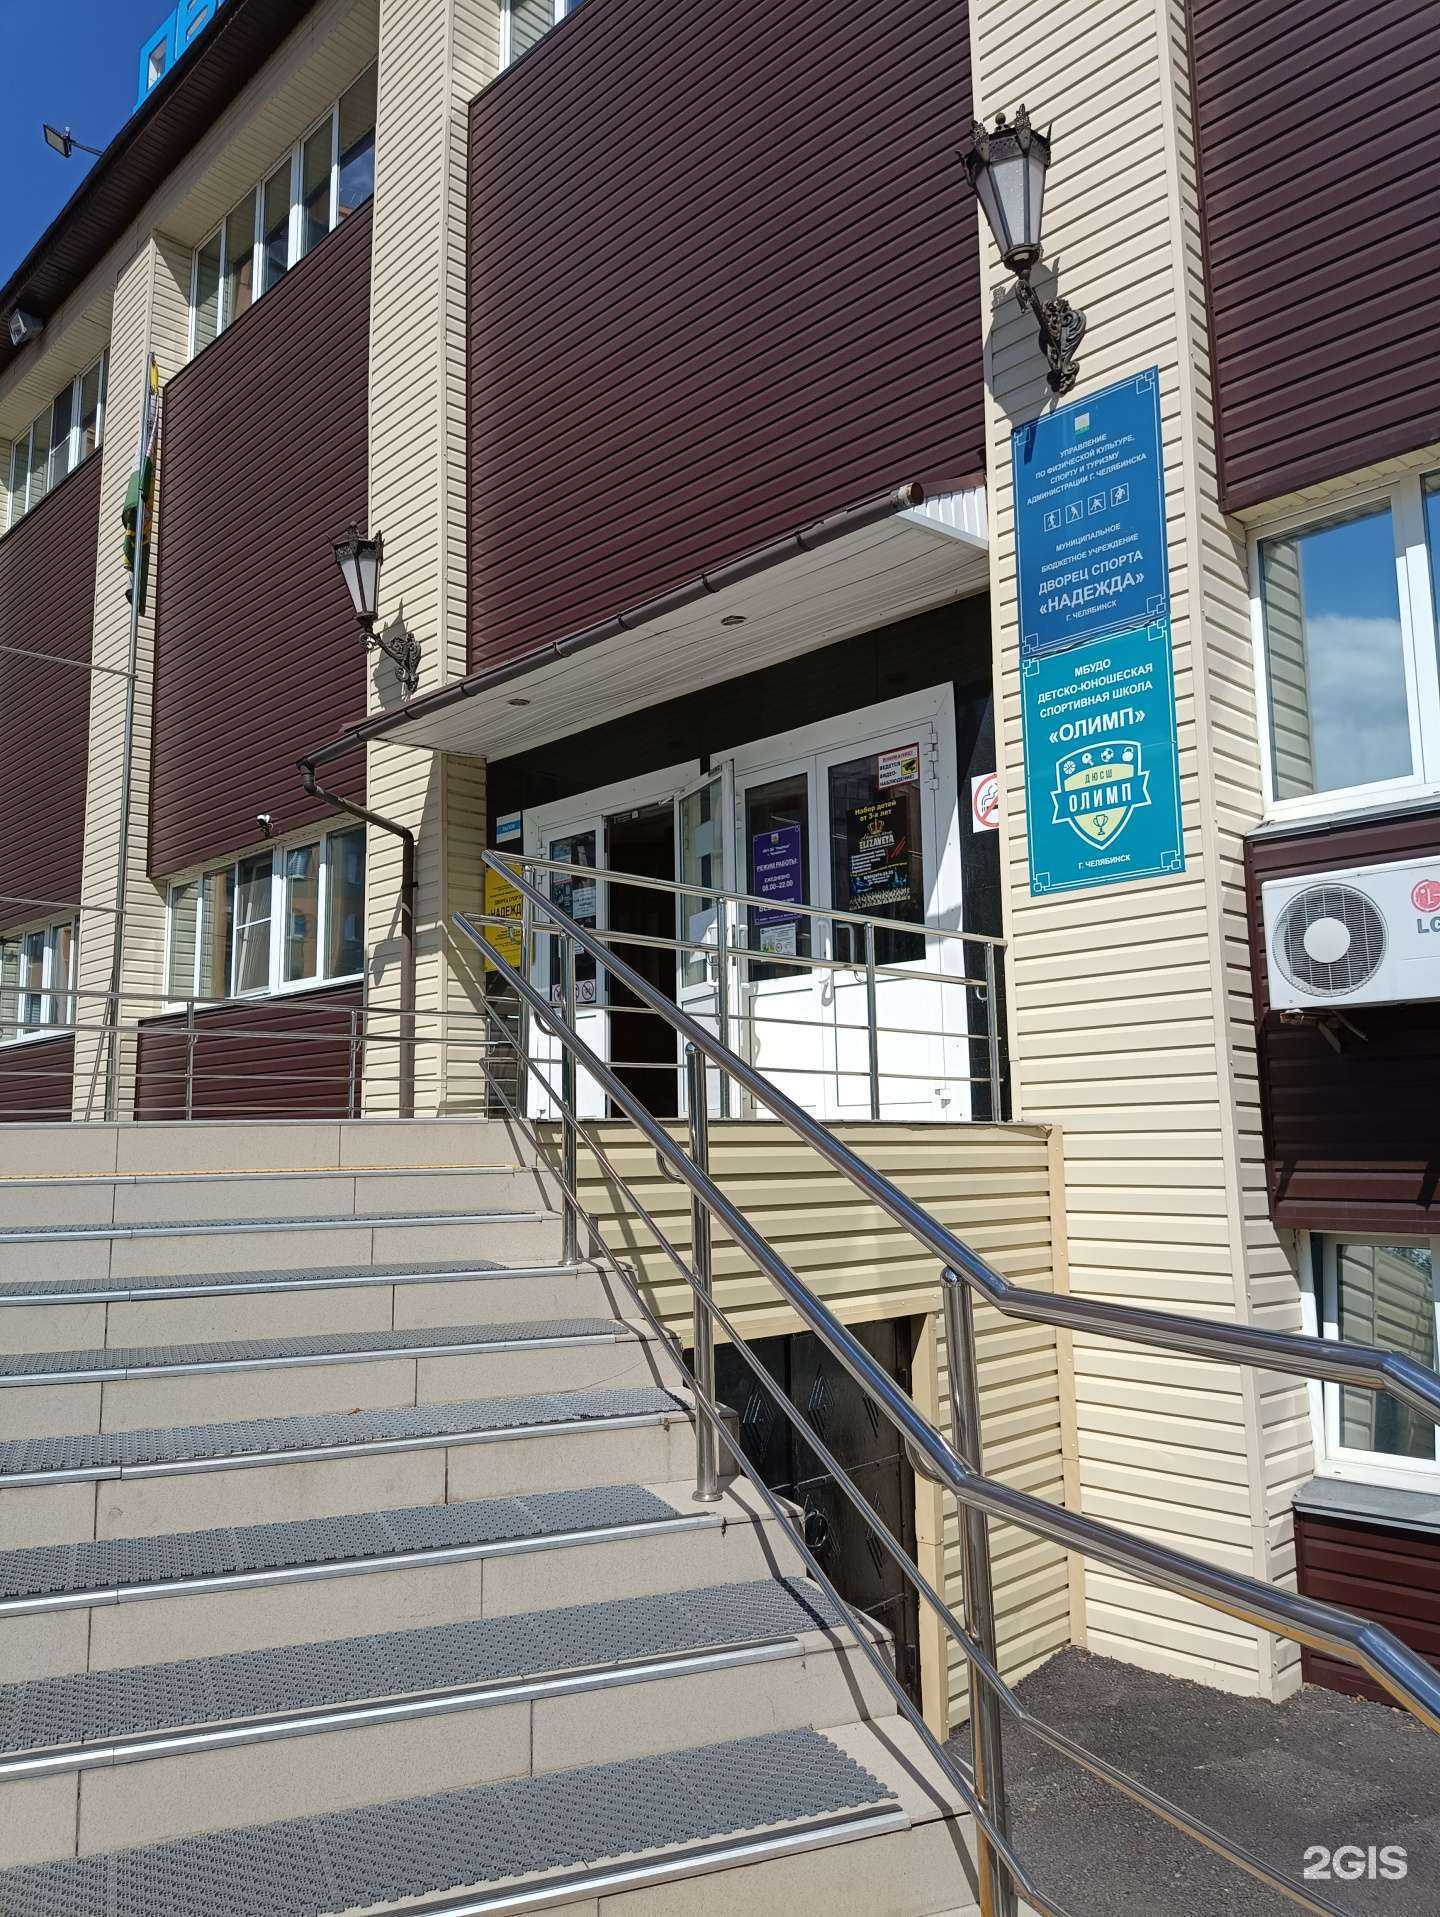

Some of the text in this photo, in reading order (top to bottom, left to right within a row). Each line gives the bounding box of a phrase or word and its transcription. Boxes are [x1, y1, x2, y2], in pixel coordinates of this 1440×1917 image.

[1059, 433, 1108, 458] УПРАВЛЕНИЕ
[1026, 452, 1147, 505] АДМИНИСТРАЦИИ Г. ЧЕЛЯБИНСКА
[1035, 470, 1046, 479] ПО
[1046, 449, 1096, 475] ФИЗИЧЕСКОЙ
[1050, 468, 1078, 485] СПОРТУ
[1086, 451, 1120, 469] ТУРИЗМУ
[1041, 532, 1139, 573] БЮДЖЕТНОЕ УЧРЕЖДЕНИЕ
[1055, 522, 1121, 552] МУНИЦИПАЛЬНОЕ
[1038, 549, 1144, 596] ДВОРЕЦ СПОРТА
[1039, 571, 1145, 615] «НАДЕЖДА»
[1072, 599, 1117, 619] ЧЕЛЯБИНСК
[1037, 662, 1153, 704] ДЕТСКО-ЮНОШЕСКАЯ
[1074, 658, 1111, 678] МБУДО
[1039, 680, 1153, 718] СПОРТИВНАЯ ШКОЛА
[1048, 706, 1146, 744] «ОЛИМП»
[1084, 768, 1113, 785] ДЮСШ
[1068, 782, 1132, 813] ОЛИМП
[859, 834, 895, 850] ELIZAVETA
[1085, 854, 1131, 868] ЧЕЛЯБИНСК
